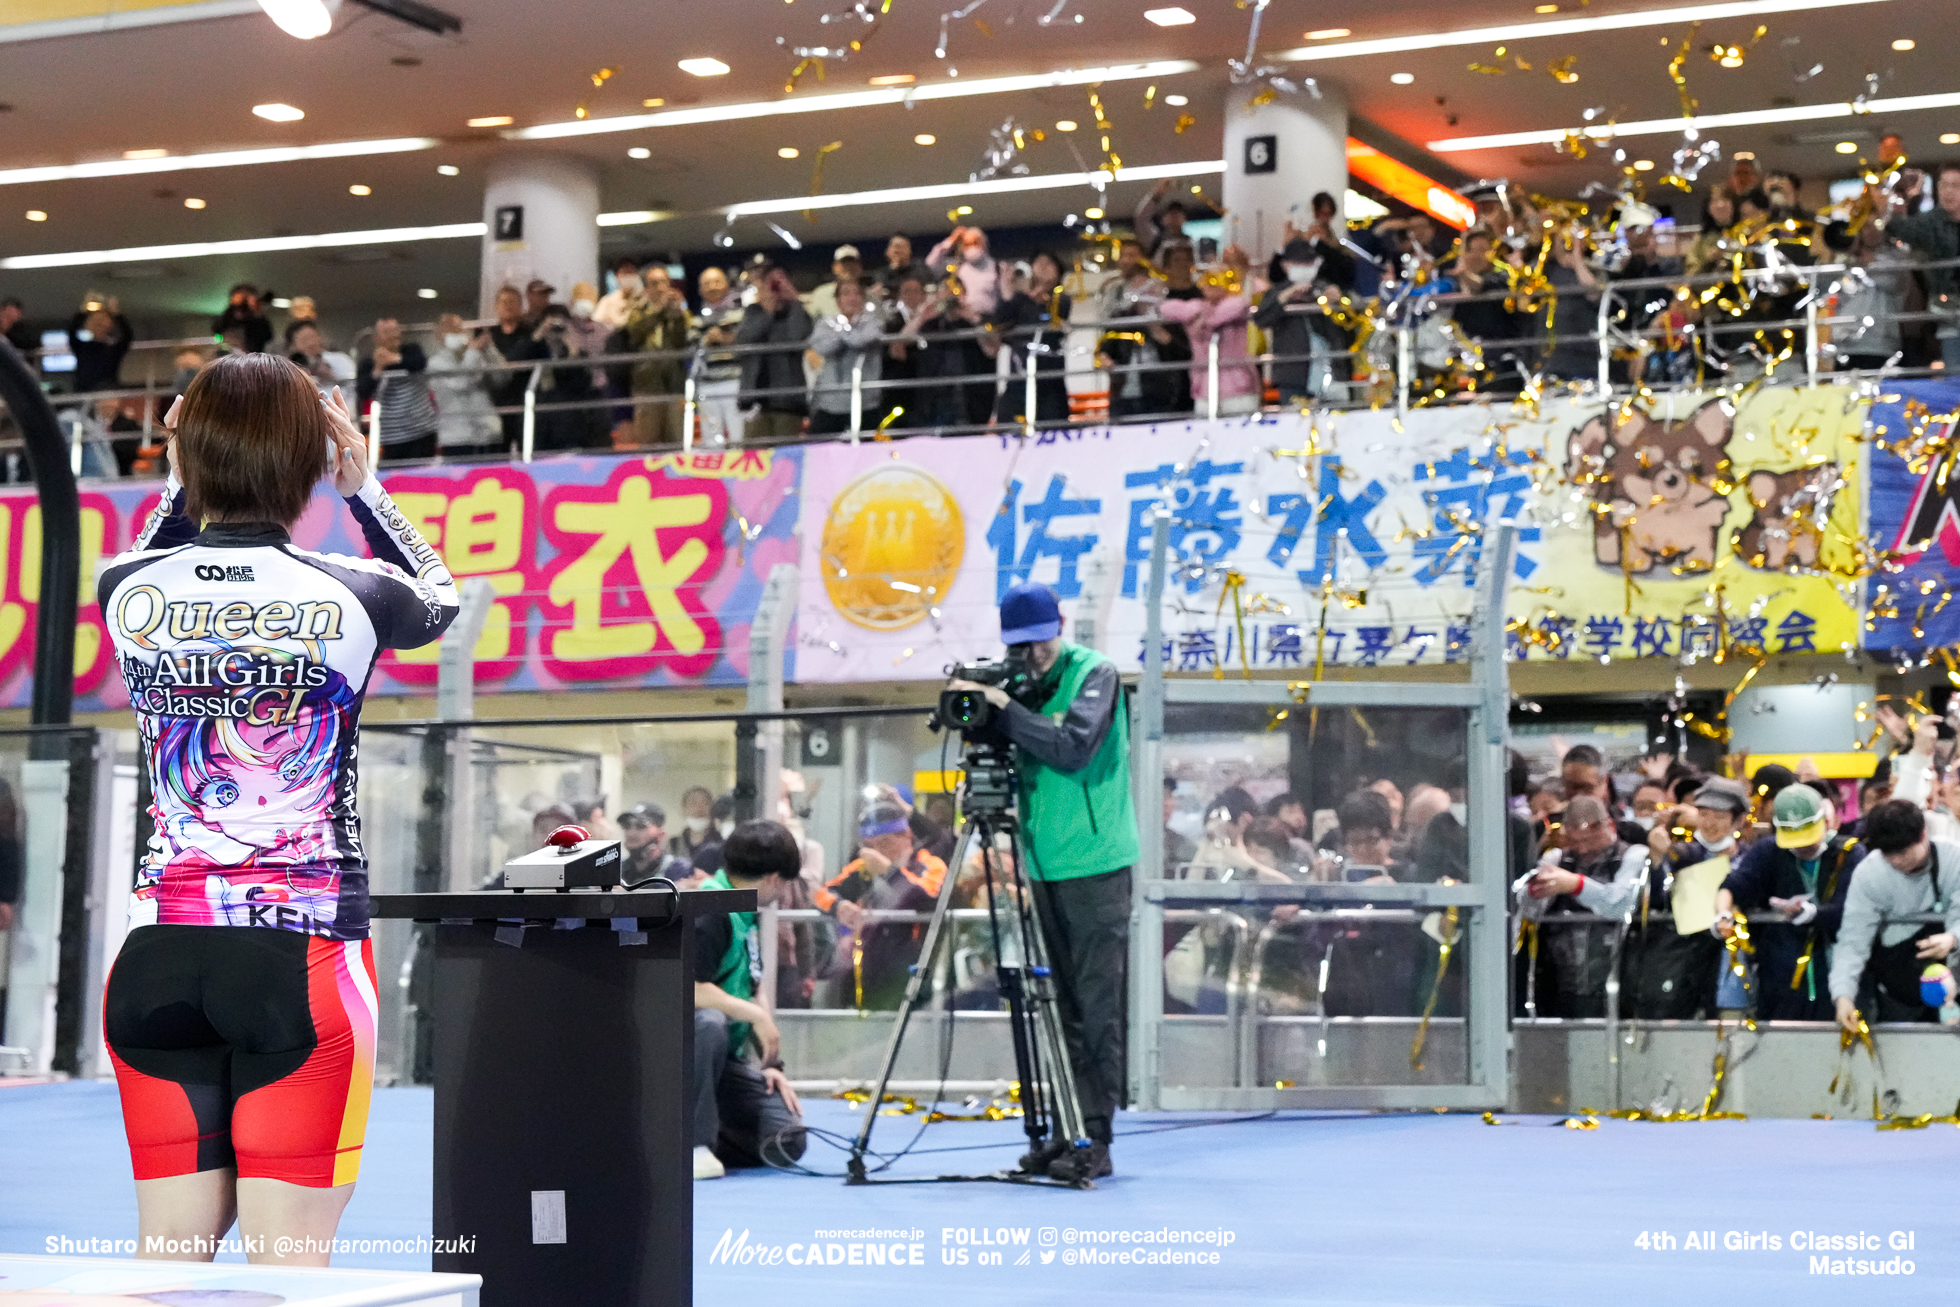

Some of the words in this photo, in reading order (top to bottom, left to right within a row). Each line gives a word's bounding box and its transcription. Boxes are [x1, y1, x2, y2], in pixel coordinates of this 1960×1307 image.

[1250, 140, 1269, 166] 6
[501, 210, 517, 234] 7
[985, 448, 1544, 607] 佐藤水菜
[116, 584, 343, 651] Queen
[127, 659, 152, 679] 4th
[151, 652, 213, 687] All
[216, 651, 328, 688] Girls
[144, 686, 249, 717] Classic
[245, 687, 311, 728] GI
[808, 728, 830, 758] 6
